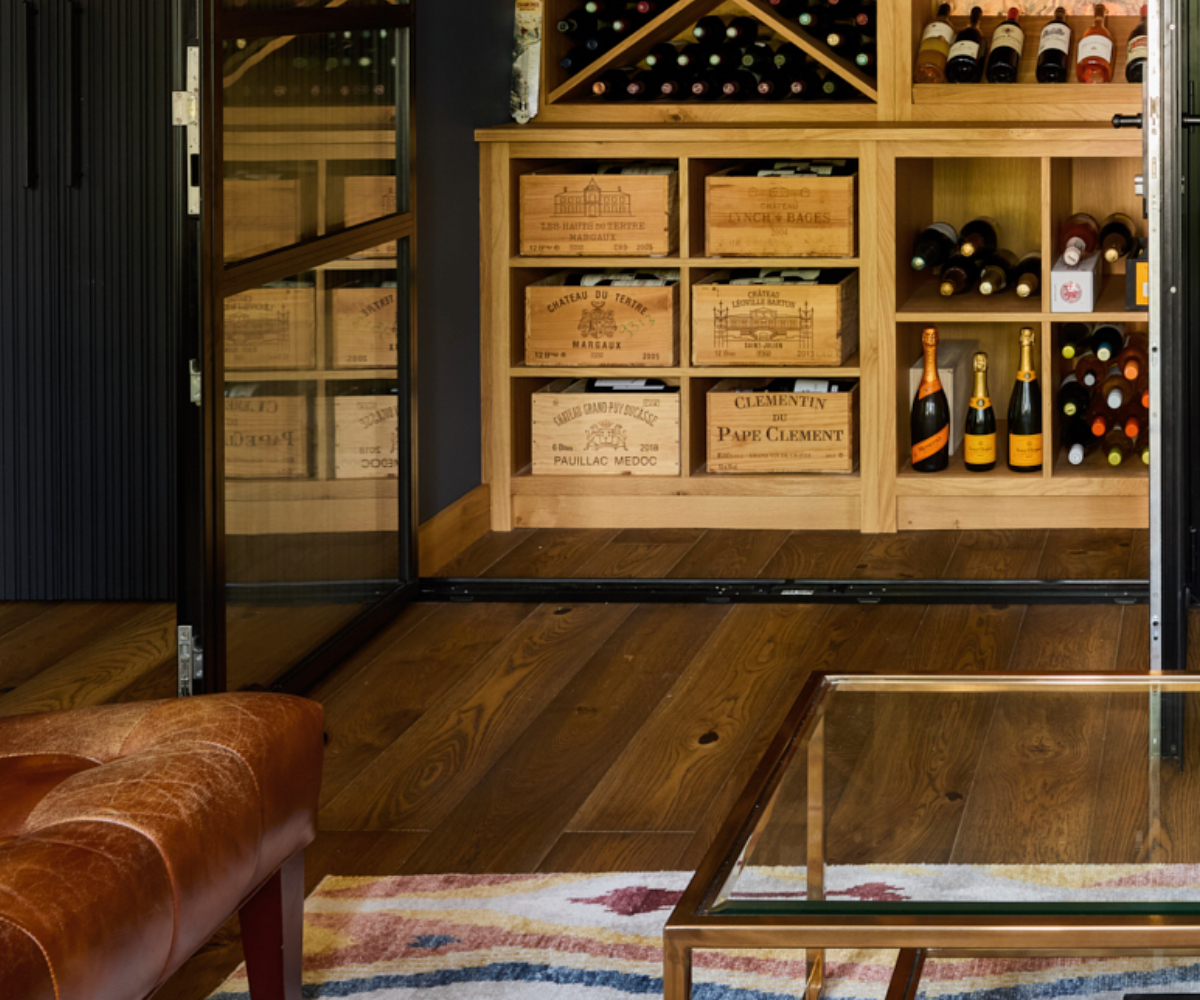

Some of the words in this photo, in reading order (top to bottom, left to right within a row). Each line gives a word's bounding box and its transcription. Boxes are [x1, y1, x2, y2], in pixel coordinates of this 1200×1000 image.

[728, 212, 771, 223] LYNCH
[787, 212, 831, 223] BAGES
[541, 222, 559, 231] LES
[563, 222, 593, 231] HAUTS
[605, 221, 645, 230] TERTRE
[569, 234, 617, 242] MARGAUX
[547, 291, 588, 313] CHATEAU
[595, 290, 608, 300] DU
[615, 292, 649, 316] TERTRE
[572, 341, 622, 350] MARGAUX
[642, 352, 660, 360] 2005
[734, 394, 828, 410] CLEMENTIN
[583, 401, 608, 414] GRAND
[623, 404, 659, 427] DUCASSE
[772, 414, 787, 422] DU
[717, 426, 761, 442] PAPE
[765, 426, 844, 442] CLEMENT
[552, 443, 558, 451] 6
[639, 443, 659, 452] 2018
[554, 456, 609, 466] PAUILLAC
[614, 456, 658, 466] MEDOC
